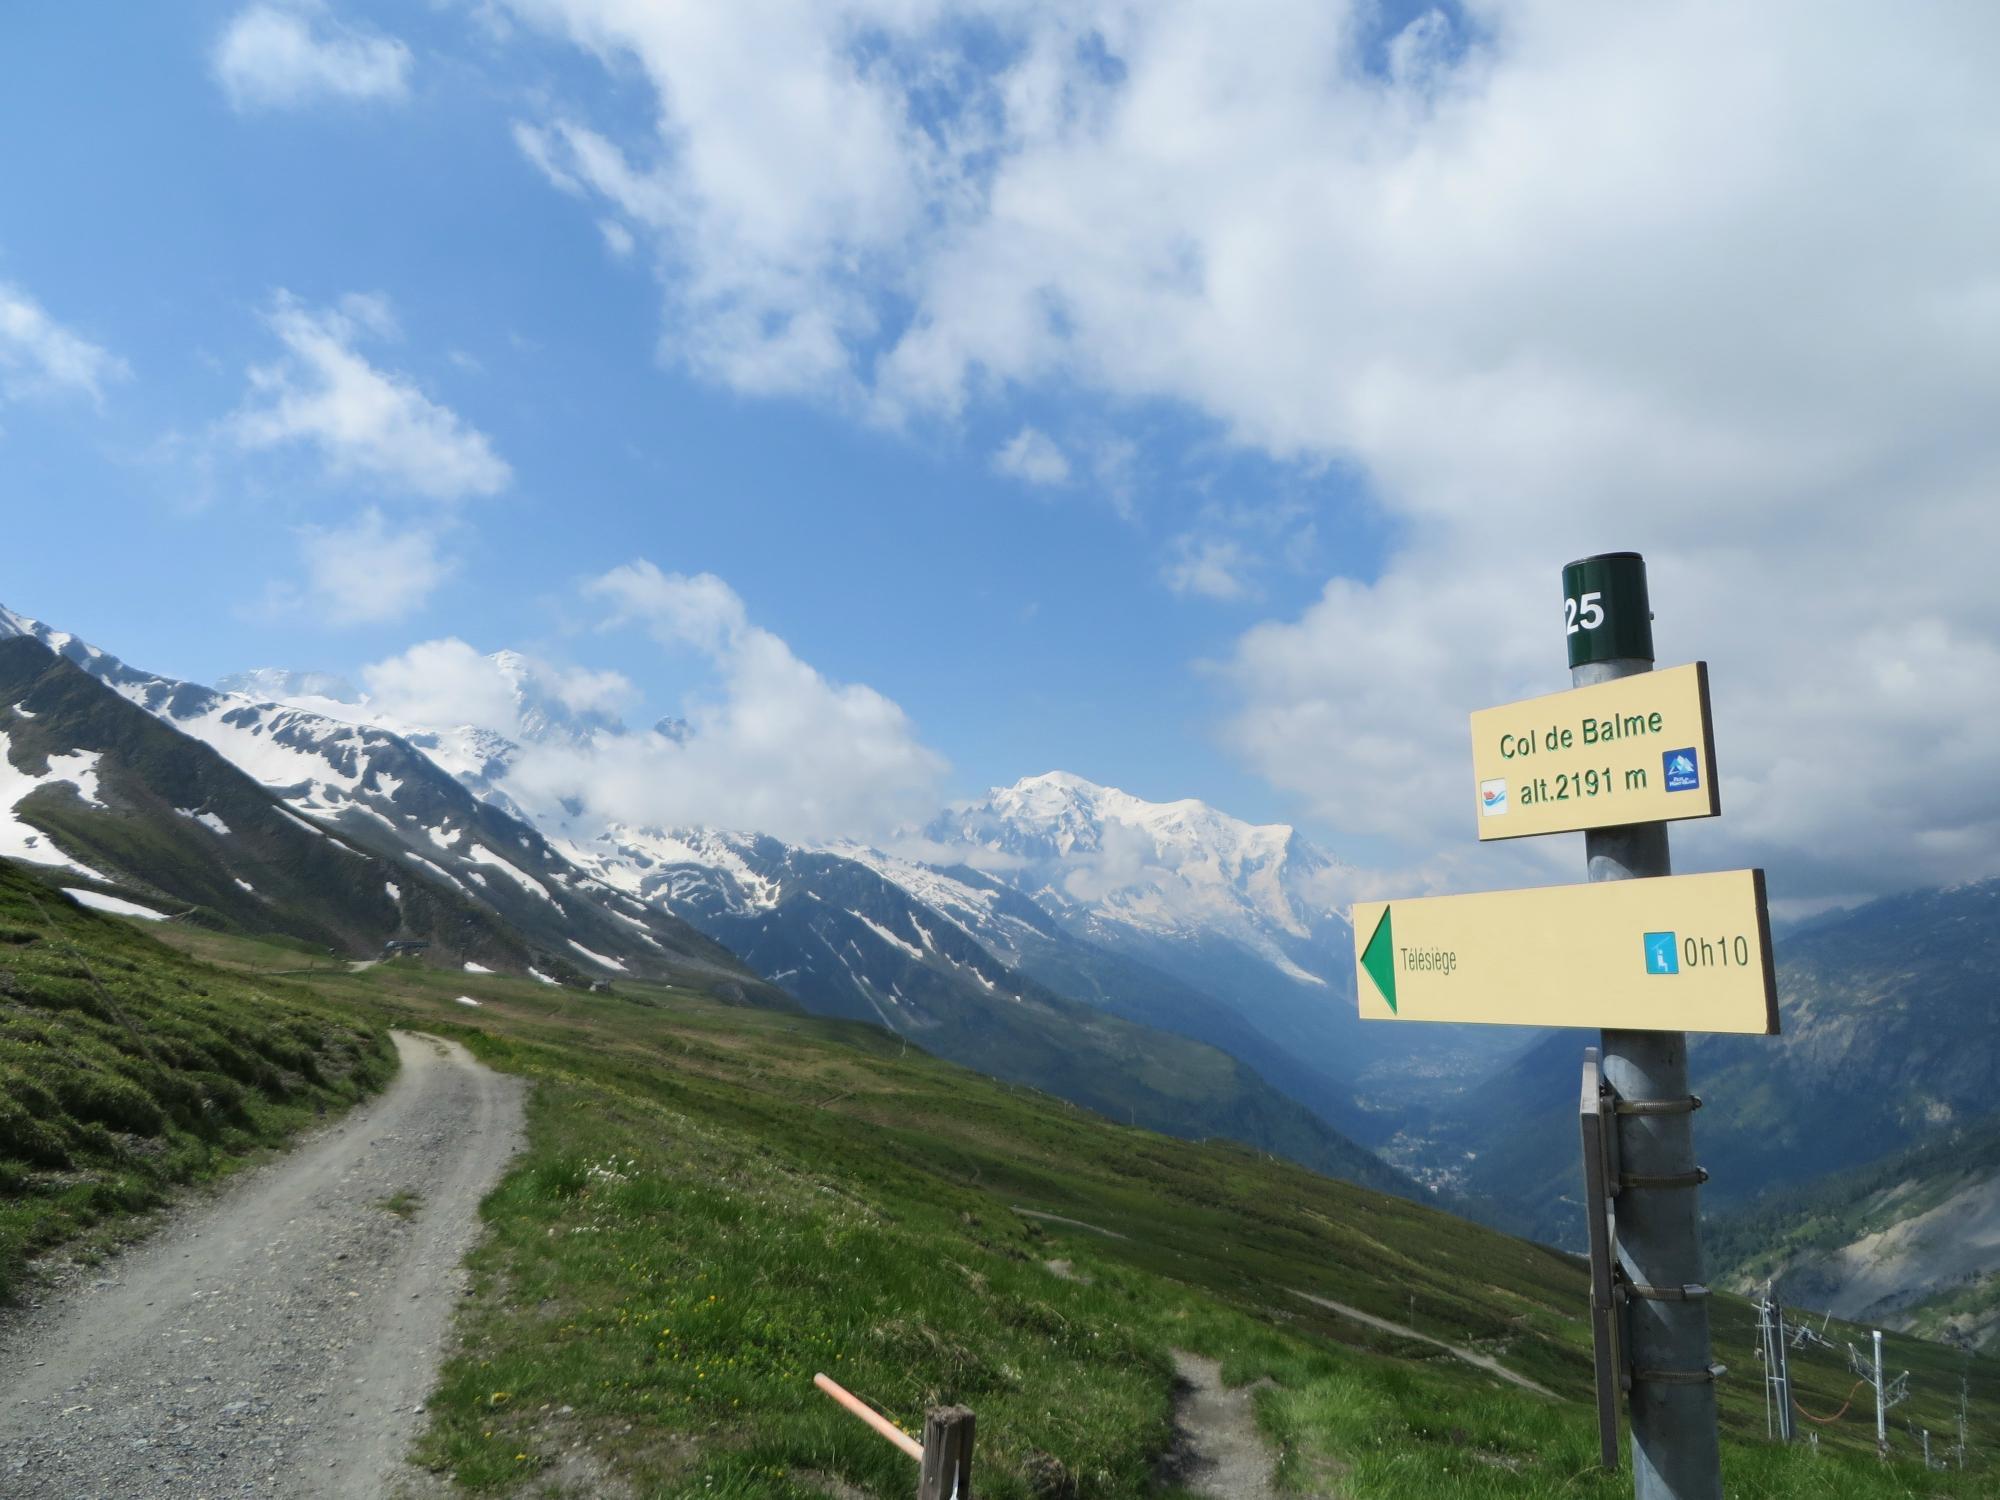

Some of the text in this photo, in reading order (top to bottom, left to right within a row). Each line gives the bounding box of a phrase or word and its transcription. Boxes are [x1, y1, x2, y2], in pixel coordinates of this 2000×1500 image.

[1564, 591, 1605, 635] 25
[1500, 711, 1663, 759] Col de Balme
[1520, 767, 1647, 805] alt.2191 m
[1401, 946, 1457, 975] Télésiège
[1684, 935, 1749, 967] 0h10
